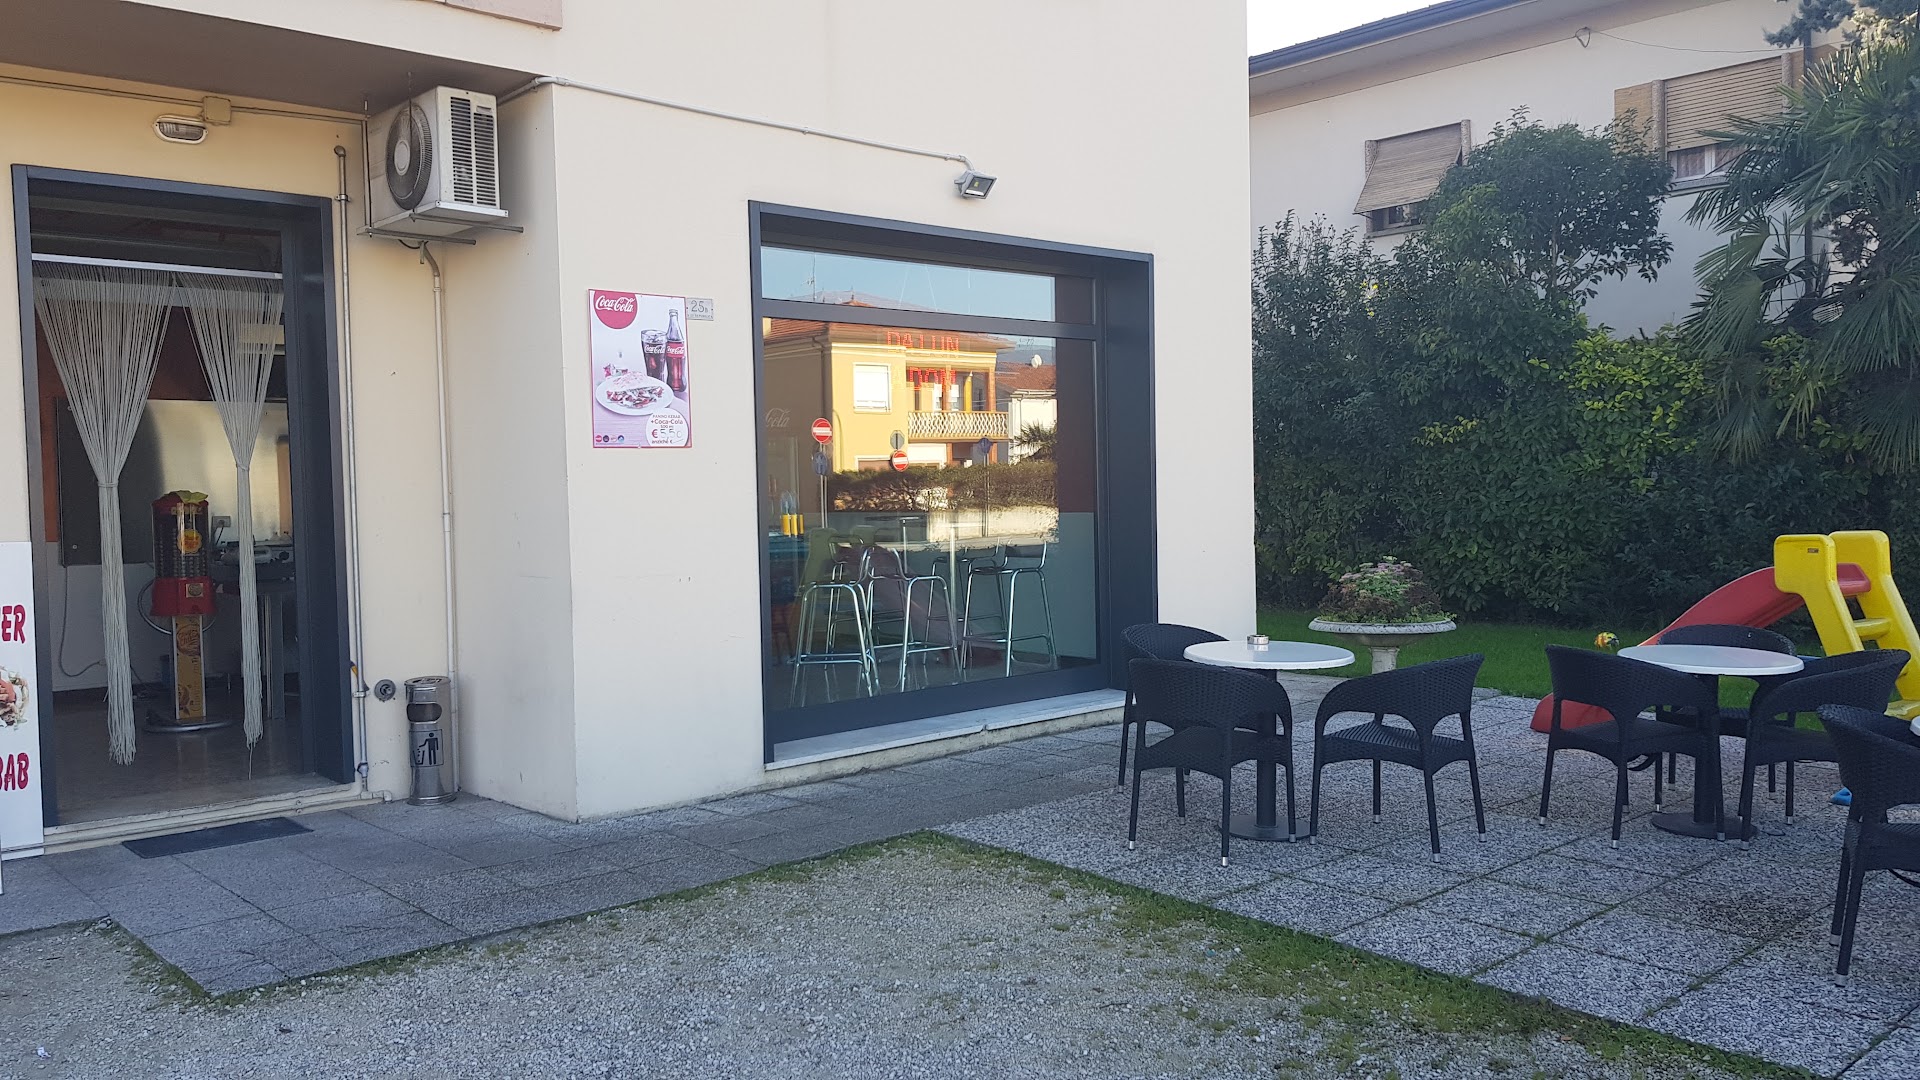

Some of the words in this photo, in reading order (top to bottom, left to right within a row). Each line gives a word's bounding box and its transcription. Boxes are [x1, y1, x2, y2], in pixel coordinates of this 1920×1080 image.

[595, 295, 635, 312] Coca-Cola
[0, 604, 26, 644] ER
[0, 752, 29, 791] AB
